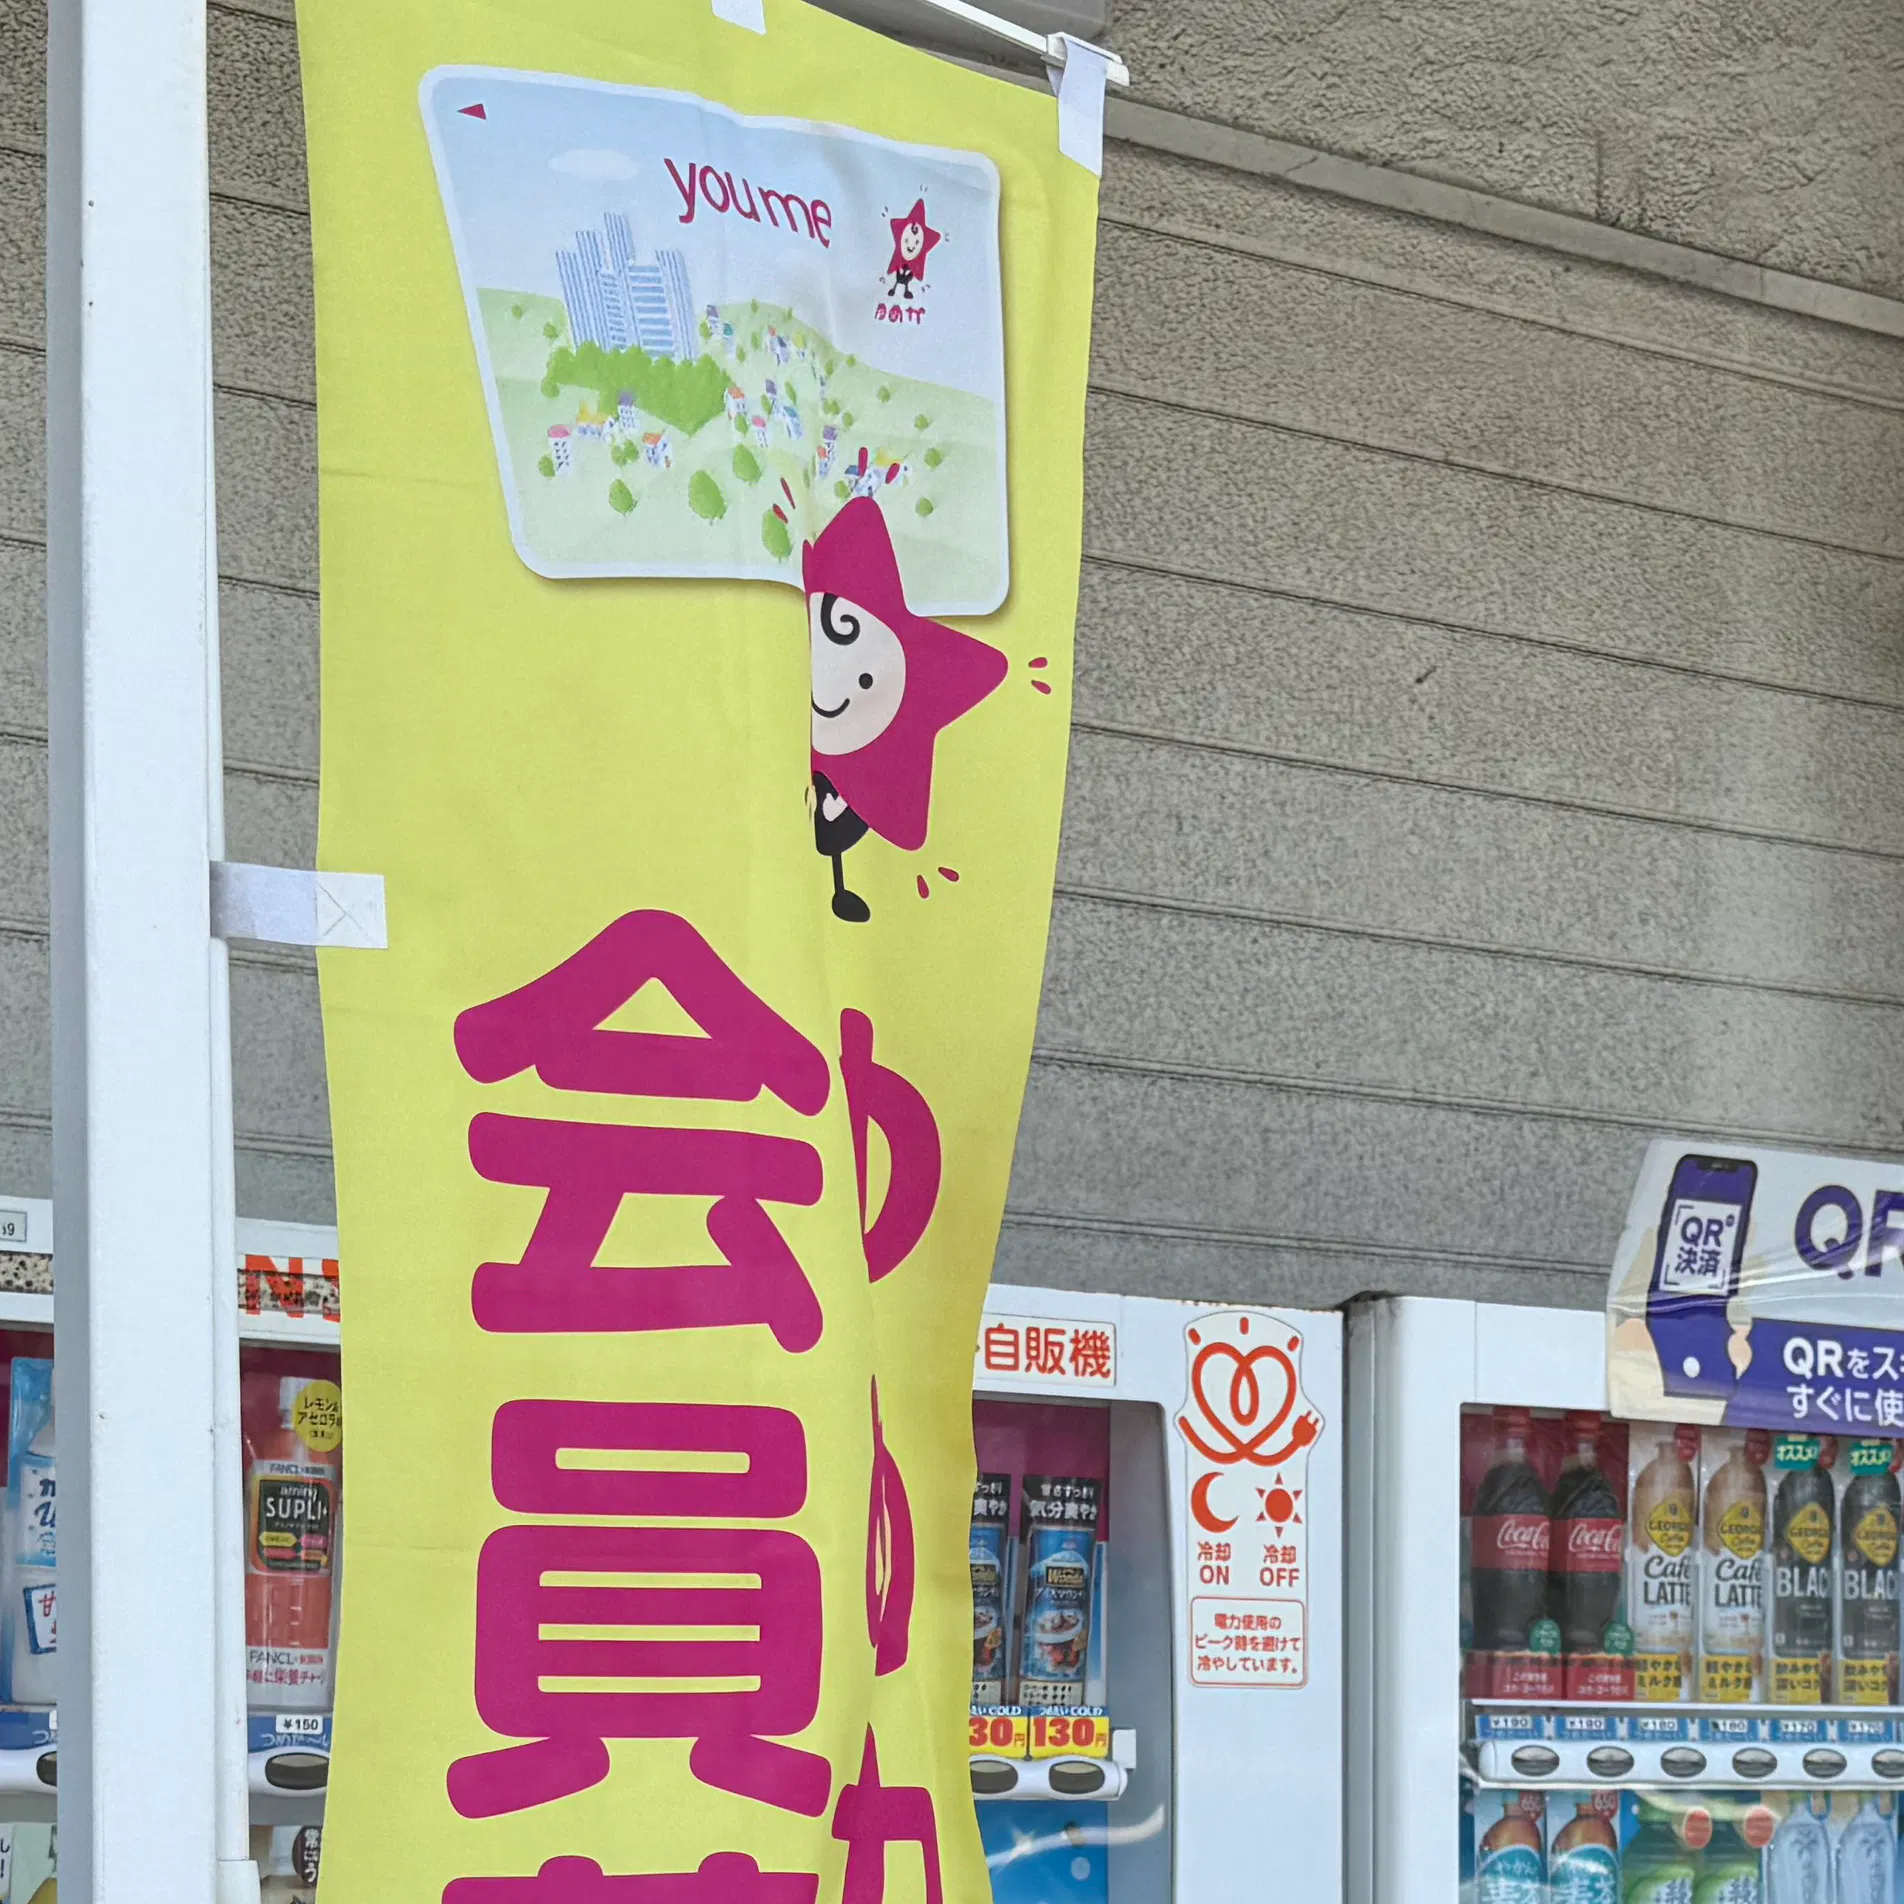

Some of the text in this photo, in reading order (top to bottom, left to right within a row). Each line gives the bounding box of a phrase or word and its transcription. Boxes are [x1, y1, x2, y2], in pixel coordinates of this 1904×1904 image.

[664, 157, 832, 248] youme
[1679, 1213, 1724, 1250] QR
[1673, 1247, 1722, 1278] 決済
[1197, 1541, 1296, 1565] 冷却 冷却
[1199, 1564, 1300, 1588] ON OFF
[1214, 1613, 1283, 1631] 電力使用の
[1195, 1633, 1302, 1652] ピーク時を避けて
[1197, 1654, 1298, 1674] 冷やしています。
